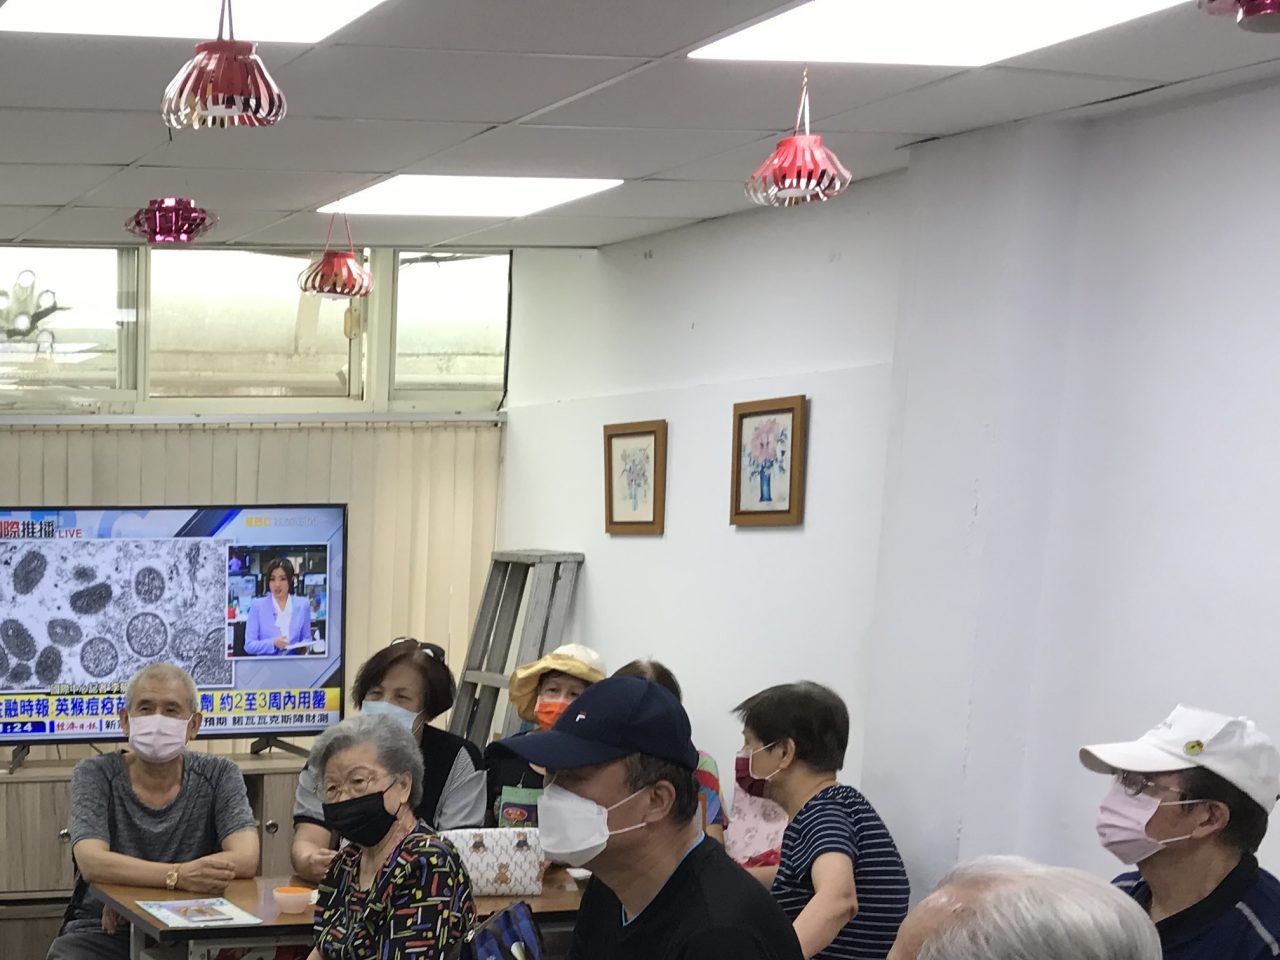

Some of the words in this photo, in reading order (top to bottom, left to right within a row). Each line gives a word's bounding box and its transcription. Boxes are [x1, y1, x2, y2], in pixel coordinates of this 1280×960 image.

[58, 528, 83, 539] LIVE
[220, 689, 326, 712] 約2至3周內用罄
